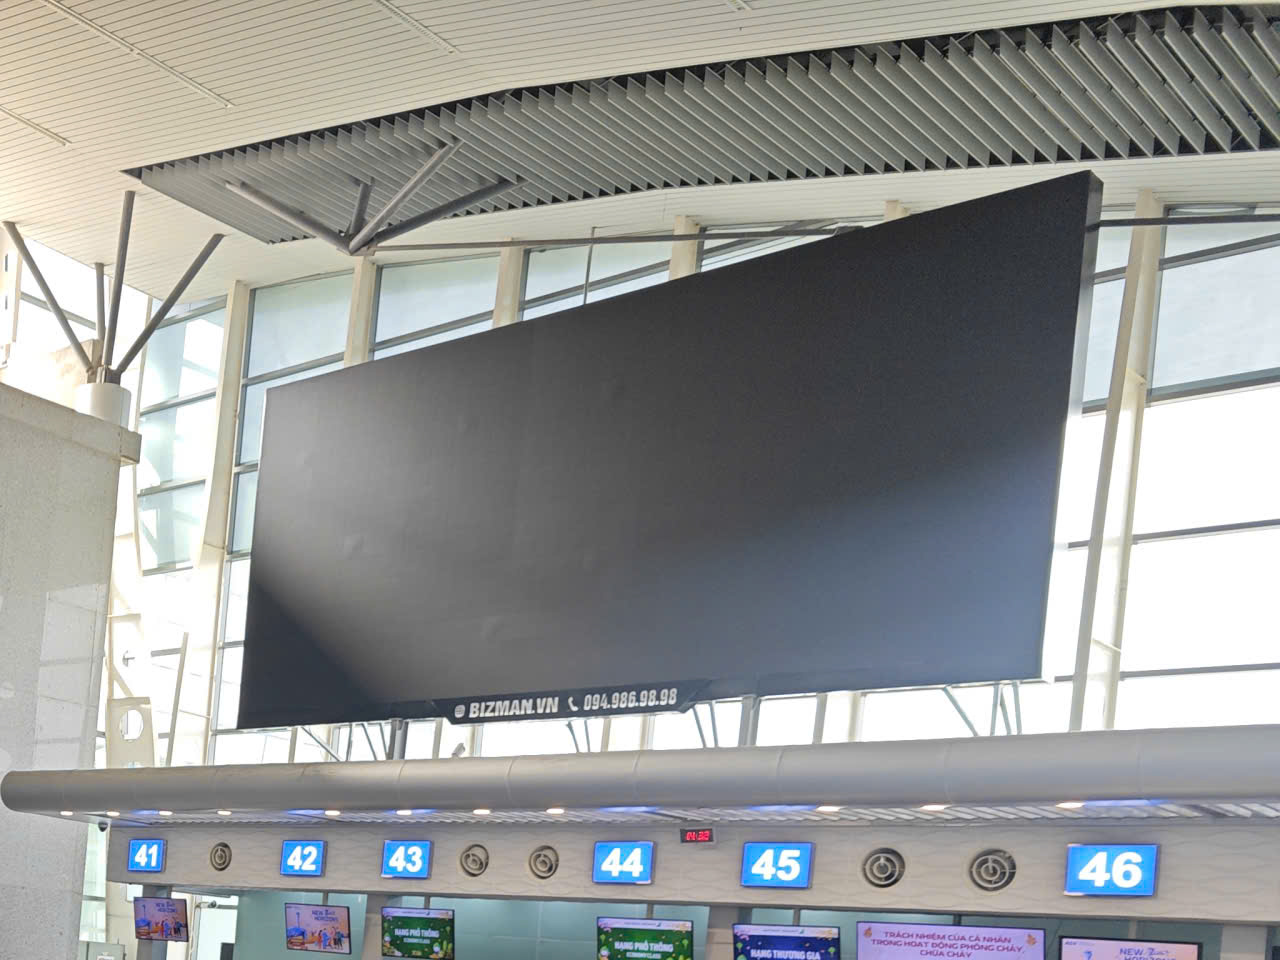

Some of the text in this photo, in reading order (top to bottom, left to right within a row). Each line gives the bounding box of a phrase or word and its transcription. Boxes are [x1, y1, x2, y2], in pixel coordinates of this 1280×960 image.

[468, 688, 678, 719] BIZMAN.VN 094.986.98.98
[133, 843, 160, 868] 41
[286, 844, 319, 871] 42
[388, 845, 424, 873] 43
[600, 847, 644, 878] 44
[751, 848, 802, 882] 45
[1077, 850, 1143, 889] 46
[750, 948, 773, 960] HẠNG
[806, 951, 822, 960] GIA
[871, 938, 903, 947] TRONG
[1119, 947, 1144, 956] NEW
